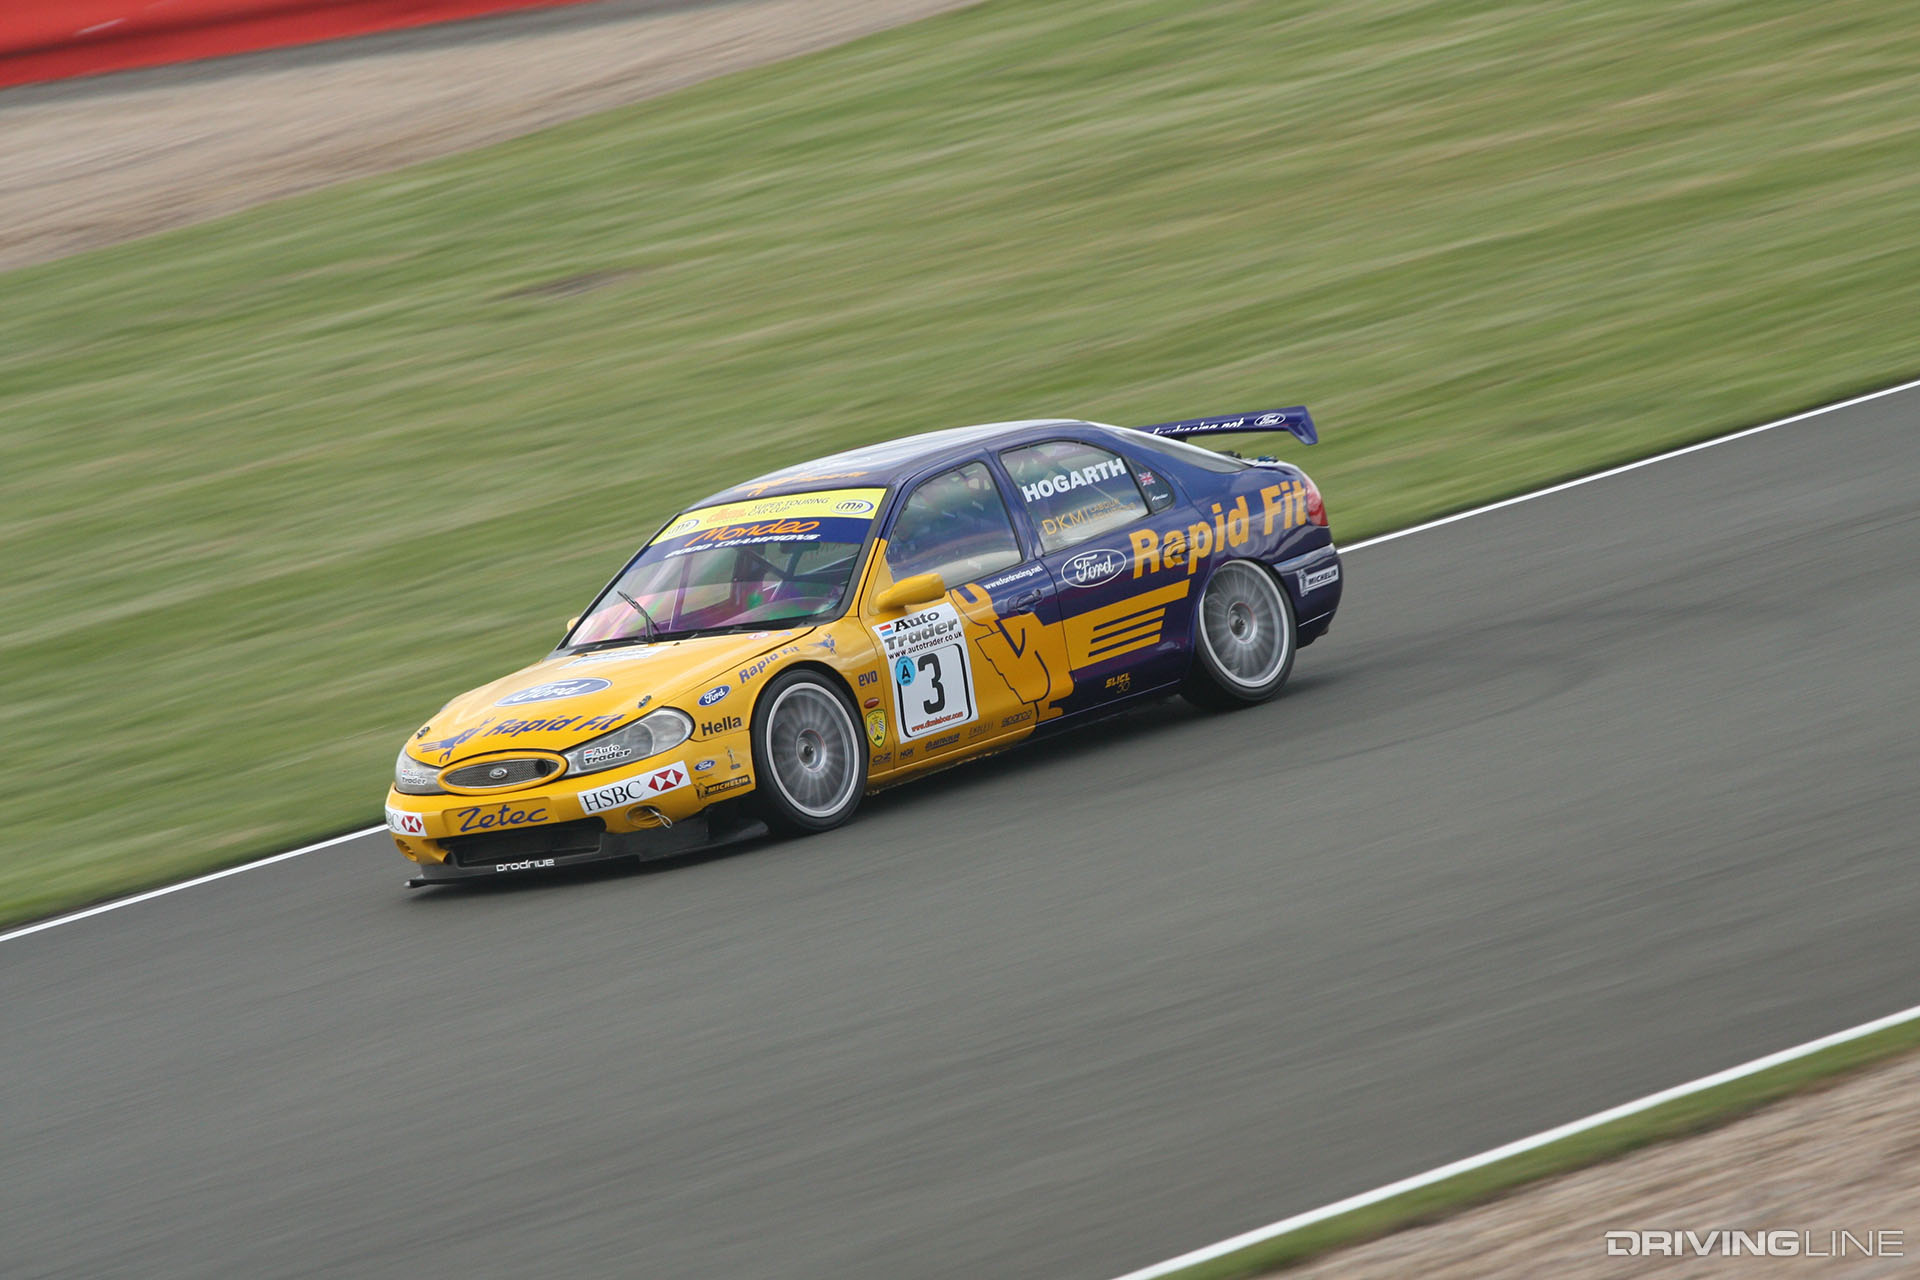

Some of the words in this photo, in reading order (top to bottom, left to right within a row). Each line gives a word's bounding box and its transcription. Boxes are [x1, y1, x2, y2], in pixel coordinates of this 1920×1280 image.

[1021, 458, 1127, 502] HOGARTH
[754, 500, 783, 510] SUPER
[785, 497, 830, 506] TOURING
[1042, 509, 1086, 535] DKM
[1129, 495, 1249, 579] Rapid
[1260, 480, 1307, 535] Fit
[684, 519, 820, 548] Mondeo
[715, 534, 821, 548] CHAMPIONS
[1073, 553, 1114, 583] Ford
[894, 611, 940, 632] Auto
[885, 618, 958, 651] Trader
[888, 631, 963, 660] www.autotrader.co.uk
[739, 653, 779, 684] Rapid
[858, 670, 878, 687] evo
[902, 664, 911, 680] A
[513, 680, 592, 702] Ford
[917, 652, 946, 715] 3
[704, 688, 726, 705] Ford
[482, 715, 583, 737] Rapid
[573, 713, 627, 731] Fit
[701, 716, 742, 737] Hella
[585, 749, 631, 765] Trader
[593, 744, 621, 757] Auto
[402, 776, 427, 785] Trader
[708, 776, 749, 793] MICHELIN
[582, 780, 645, 812] HSBC
[457, 804, 549, 833] Zetec
[496, 858, 555, 873] prodrive
